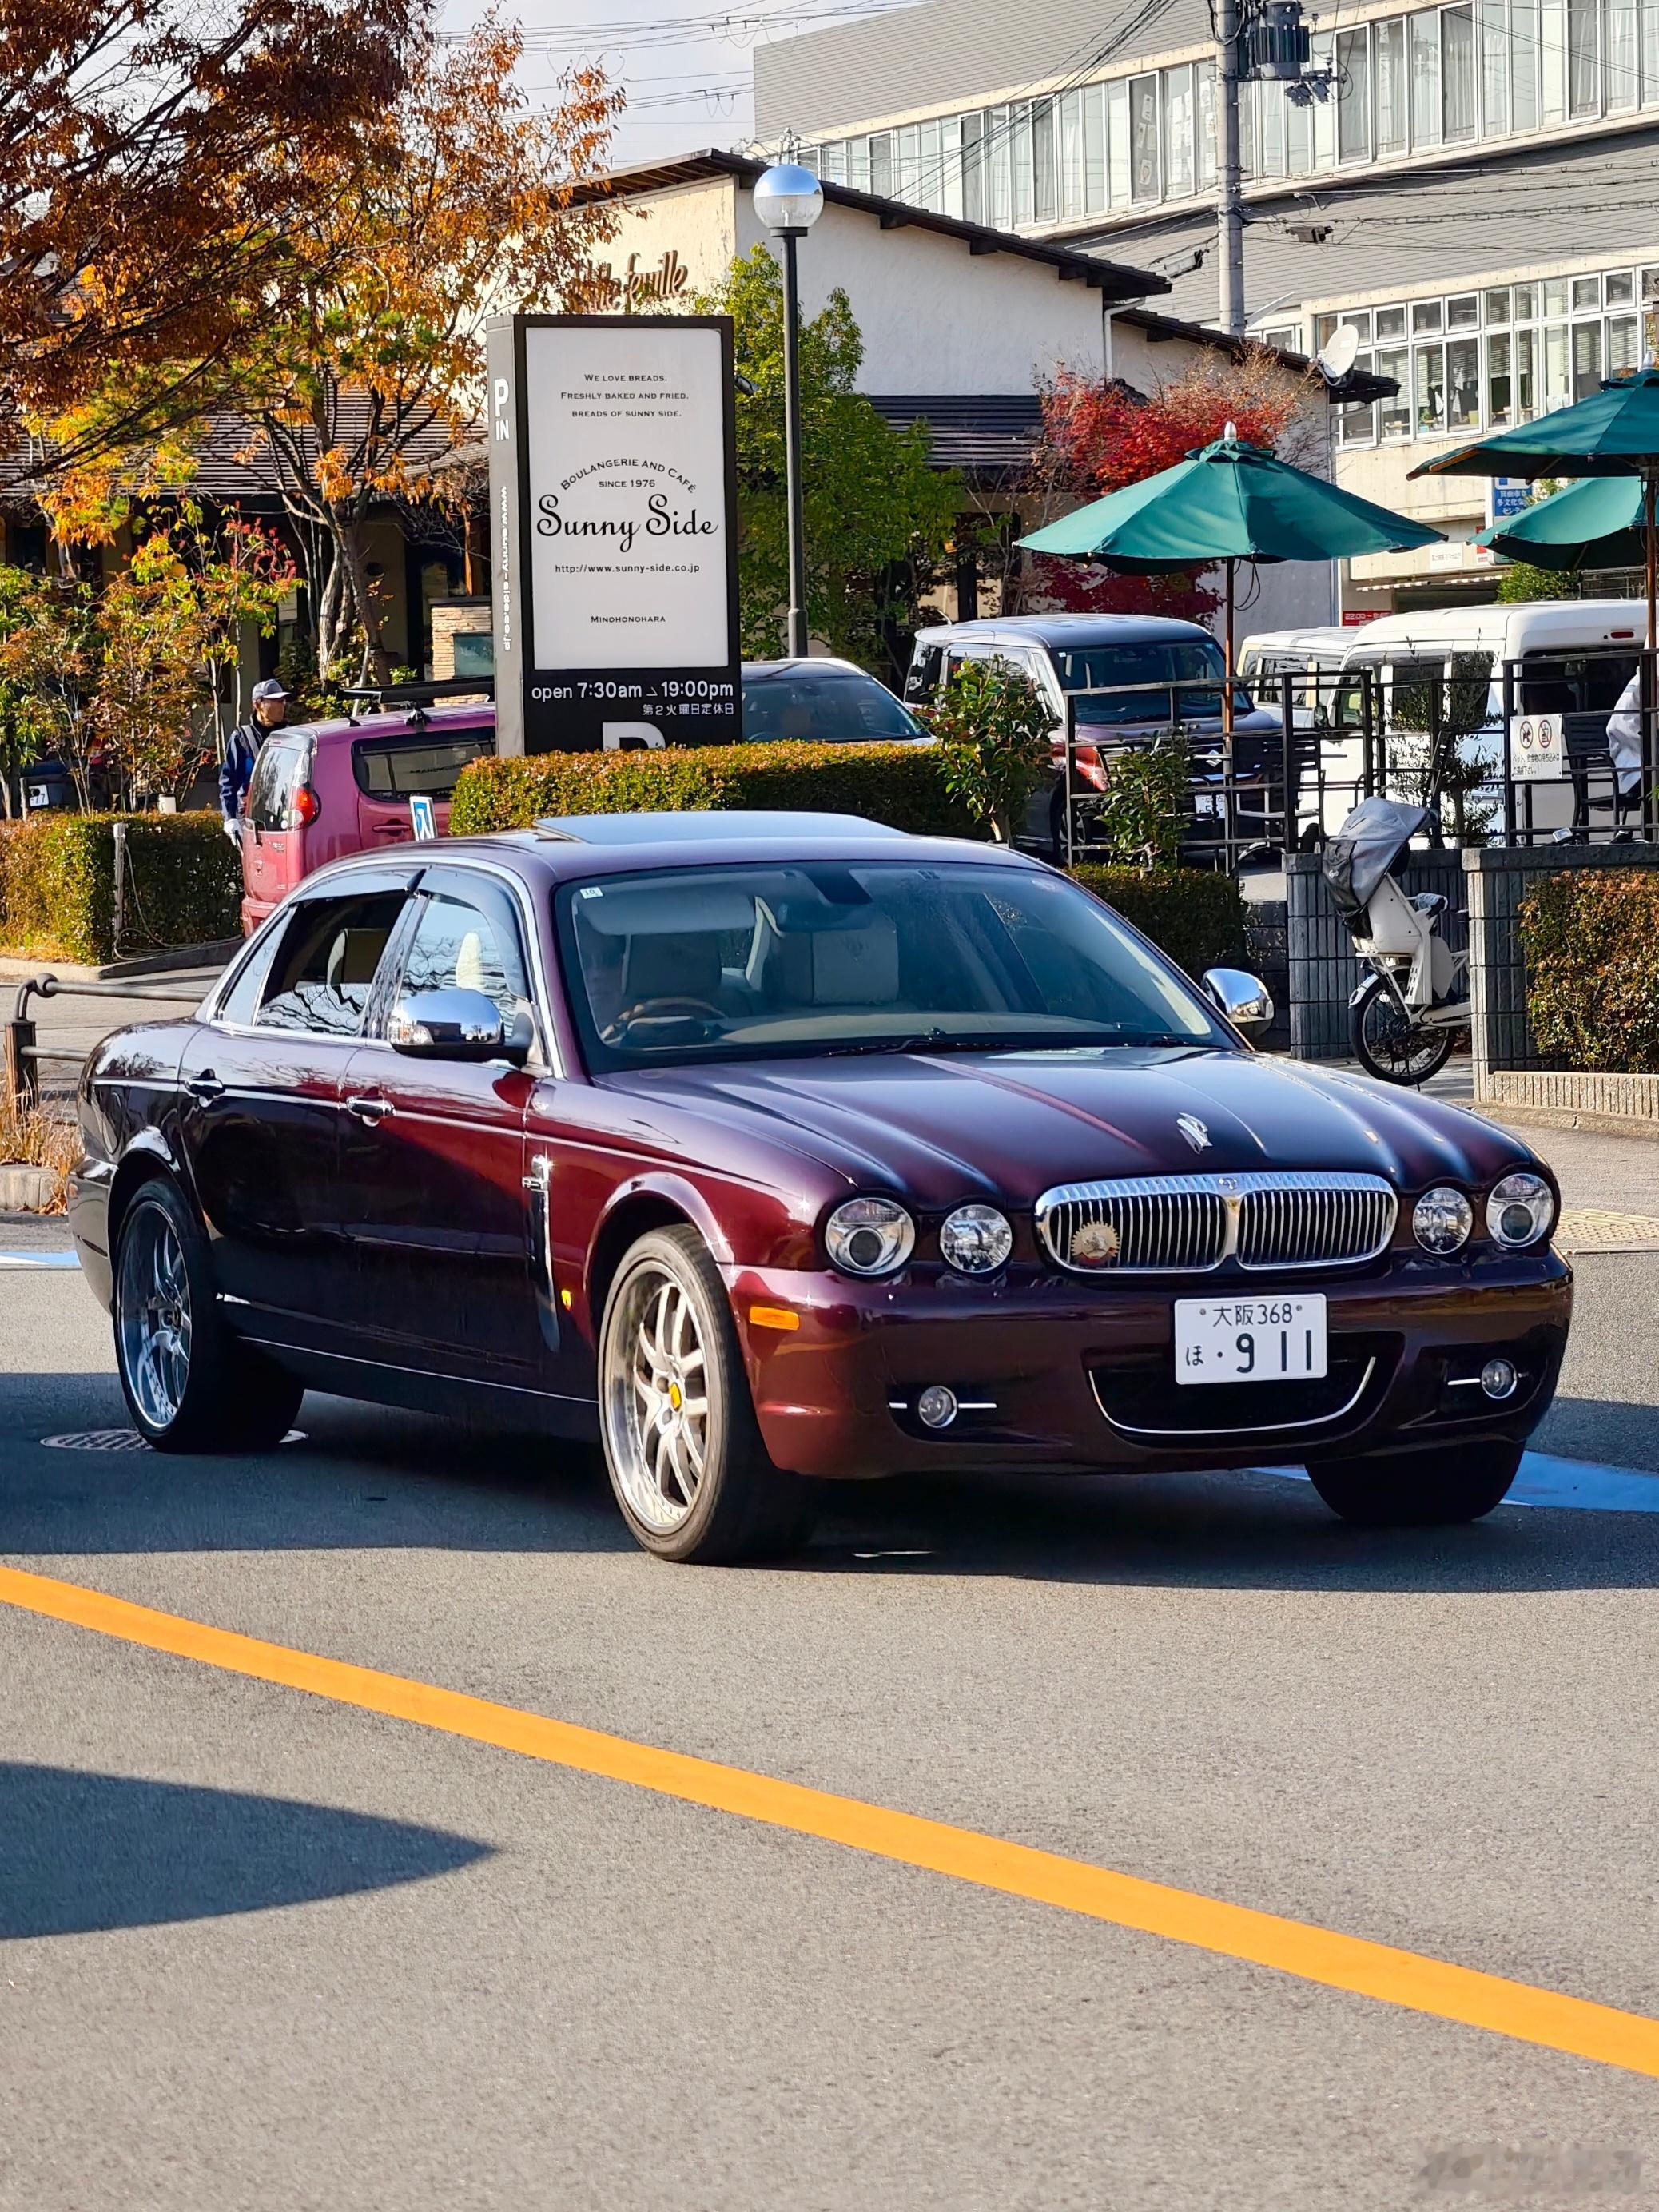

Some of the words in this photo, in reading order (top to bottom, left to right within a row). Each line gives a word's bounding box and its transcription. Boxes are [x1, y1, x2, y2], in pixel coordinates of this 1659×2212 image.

[494, 378, 509, 417] P
[495, 419, 510, 441] IN
[641, 460, 666, 473] AND
[536, 493, 641, 553] Sunny
[645, 493, 719, 536] Side
[555, 563, 700, 575] http://www.sunny-side.co.jp
[531, 686, 573, 703] open
[576, 681, 643, 698] 7:30am
[660, 680, 734, 701] 19:00pm
[1185, 1344, 1204, 1367] ほ
